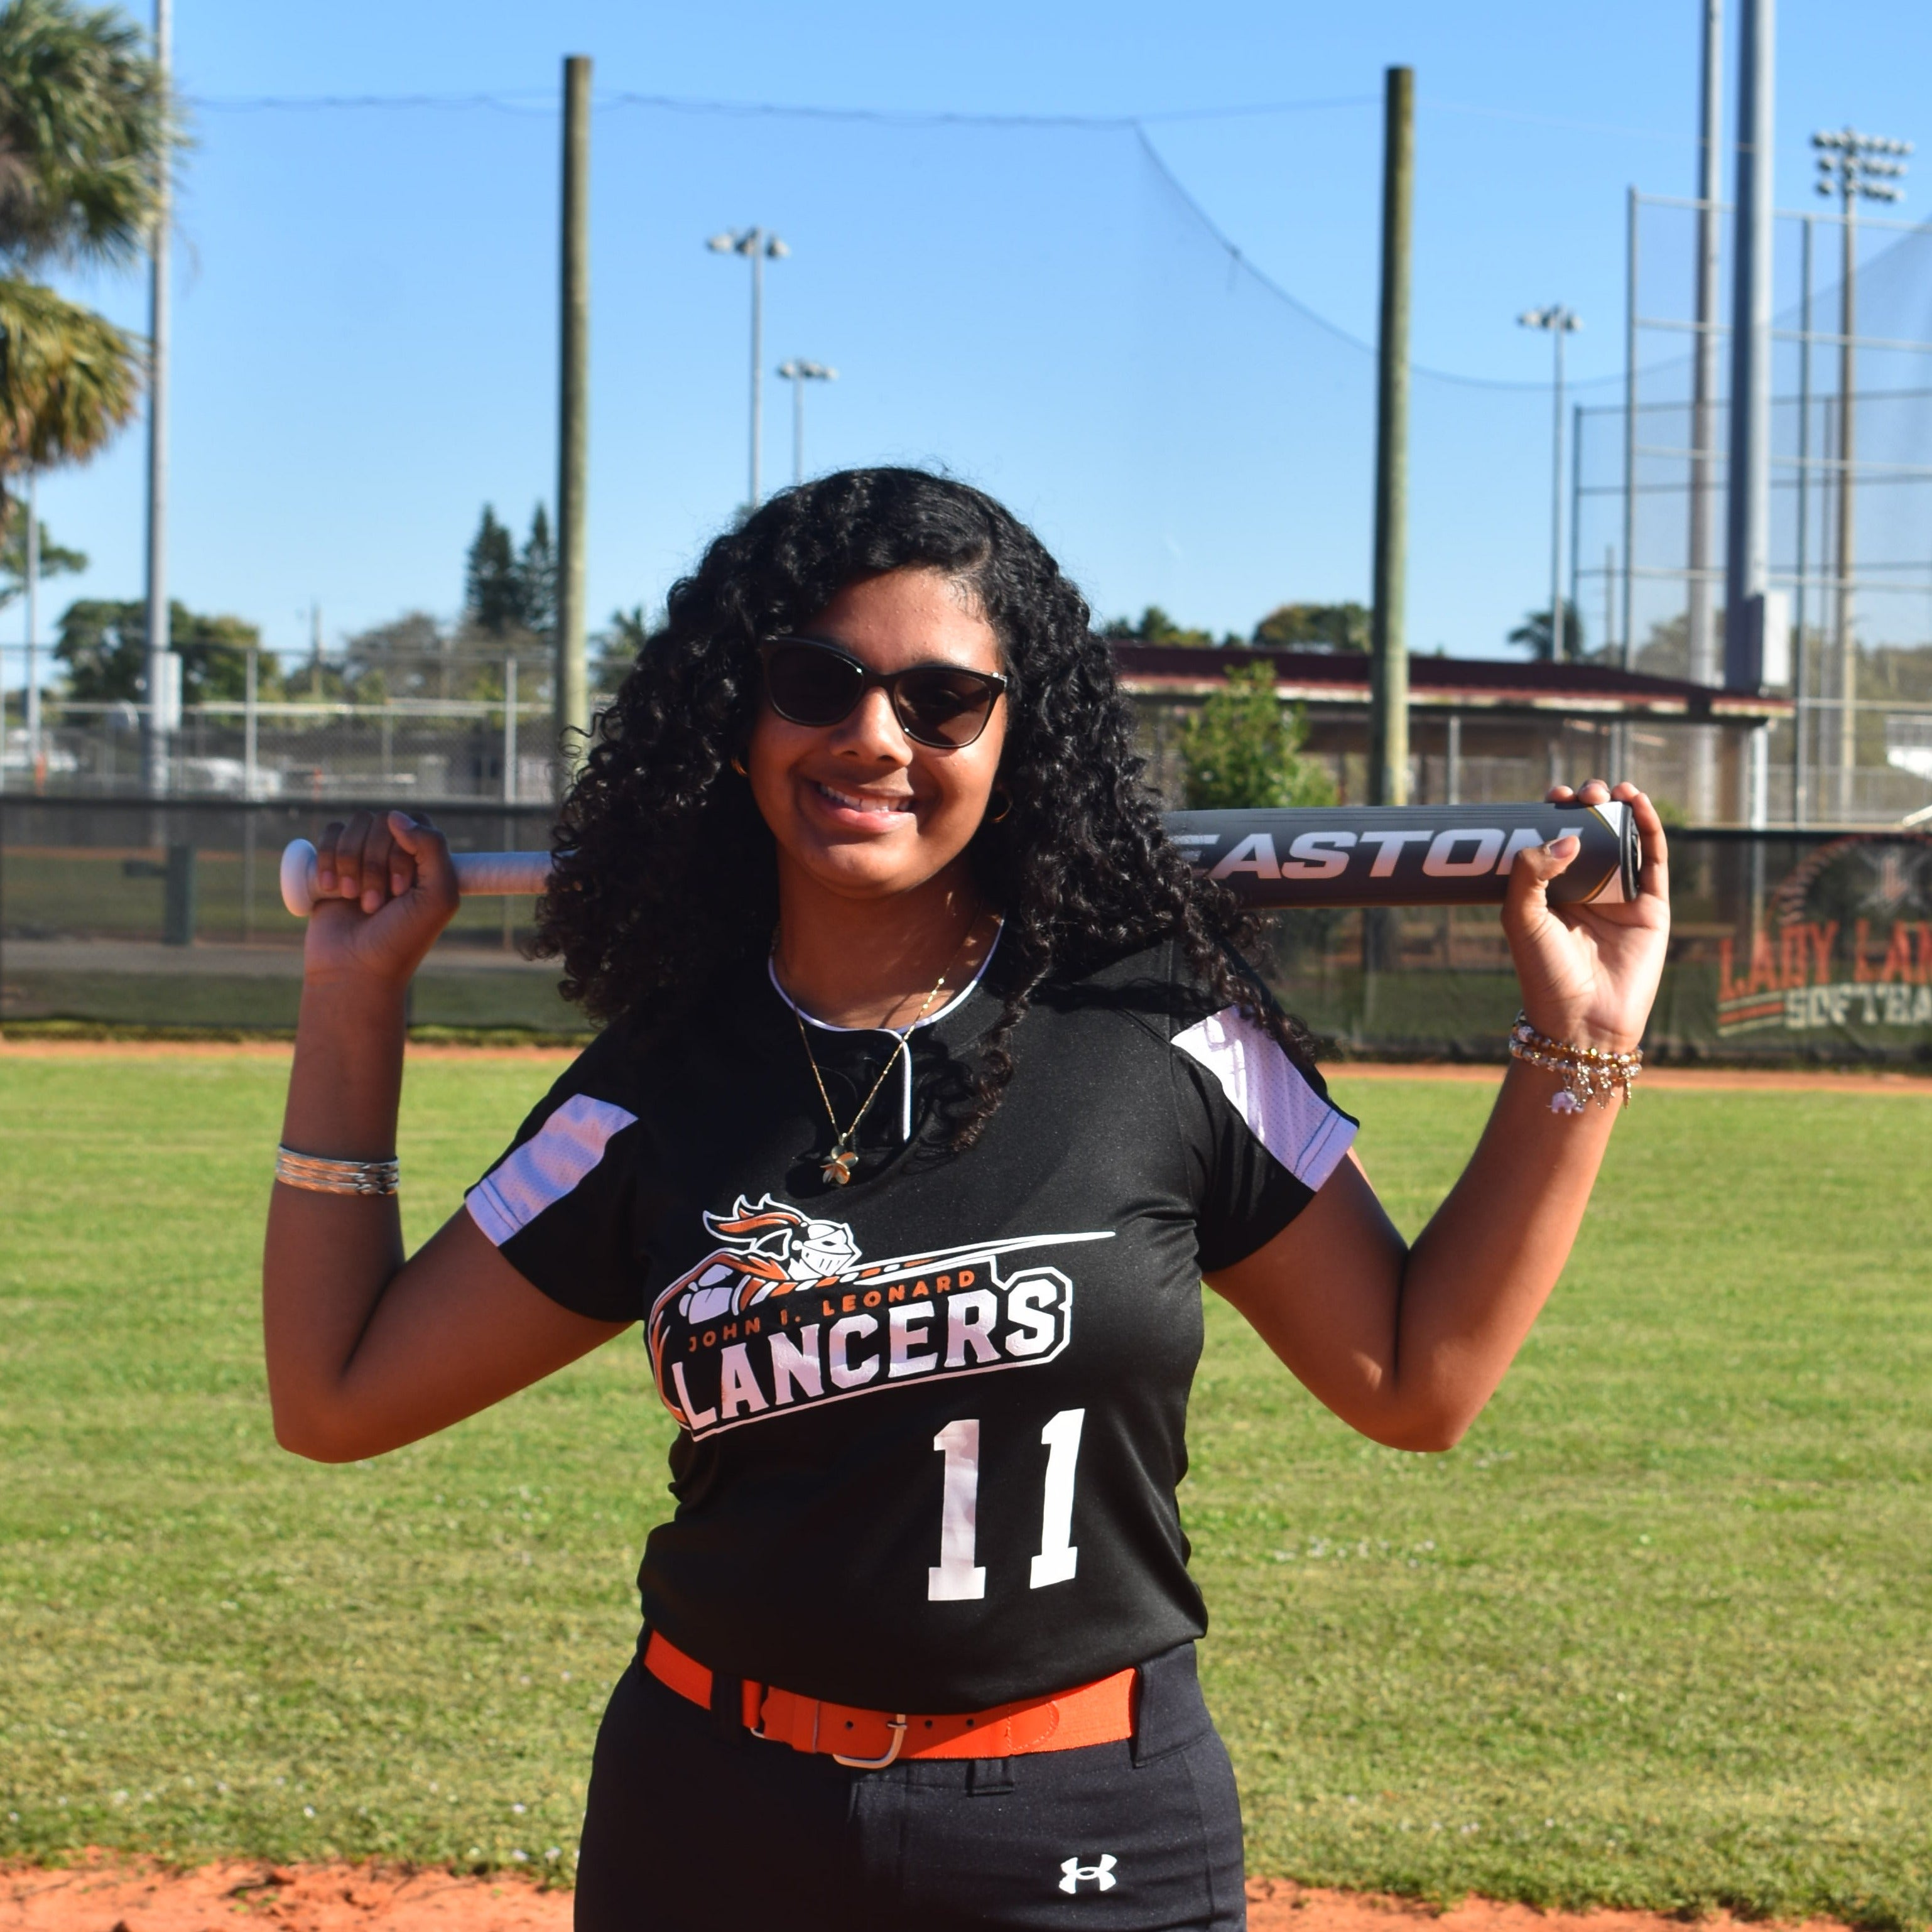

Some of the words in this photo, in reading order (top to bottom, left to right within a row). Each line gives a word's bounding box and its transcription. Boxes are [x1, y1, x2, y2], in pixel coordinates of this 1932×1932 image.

[1718, 919, 1840, 1002] LADY
[671, 1278, 1058, 1431] LANCERS
[688, 1317, 761, 1352] JOHN
[780, 1309, 801, 1326] I.
[822, 1270, 976, 1316] LEONARD
[928, 1408, 1085, 1601] 11
